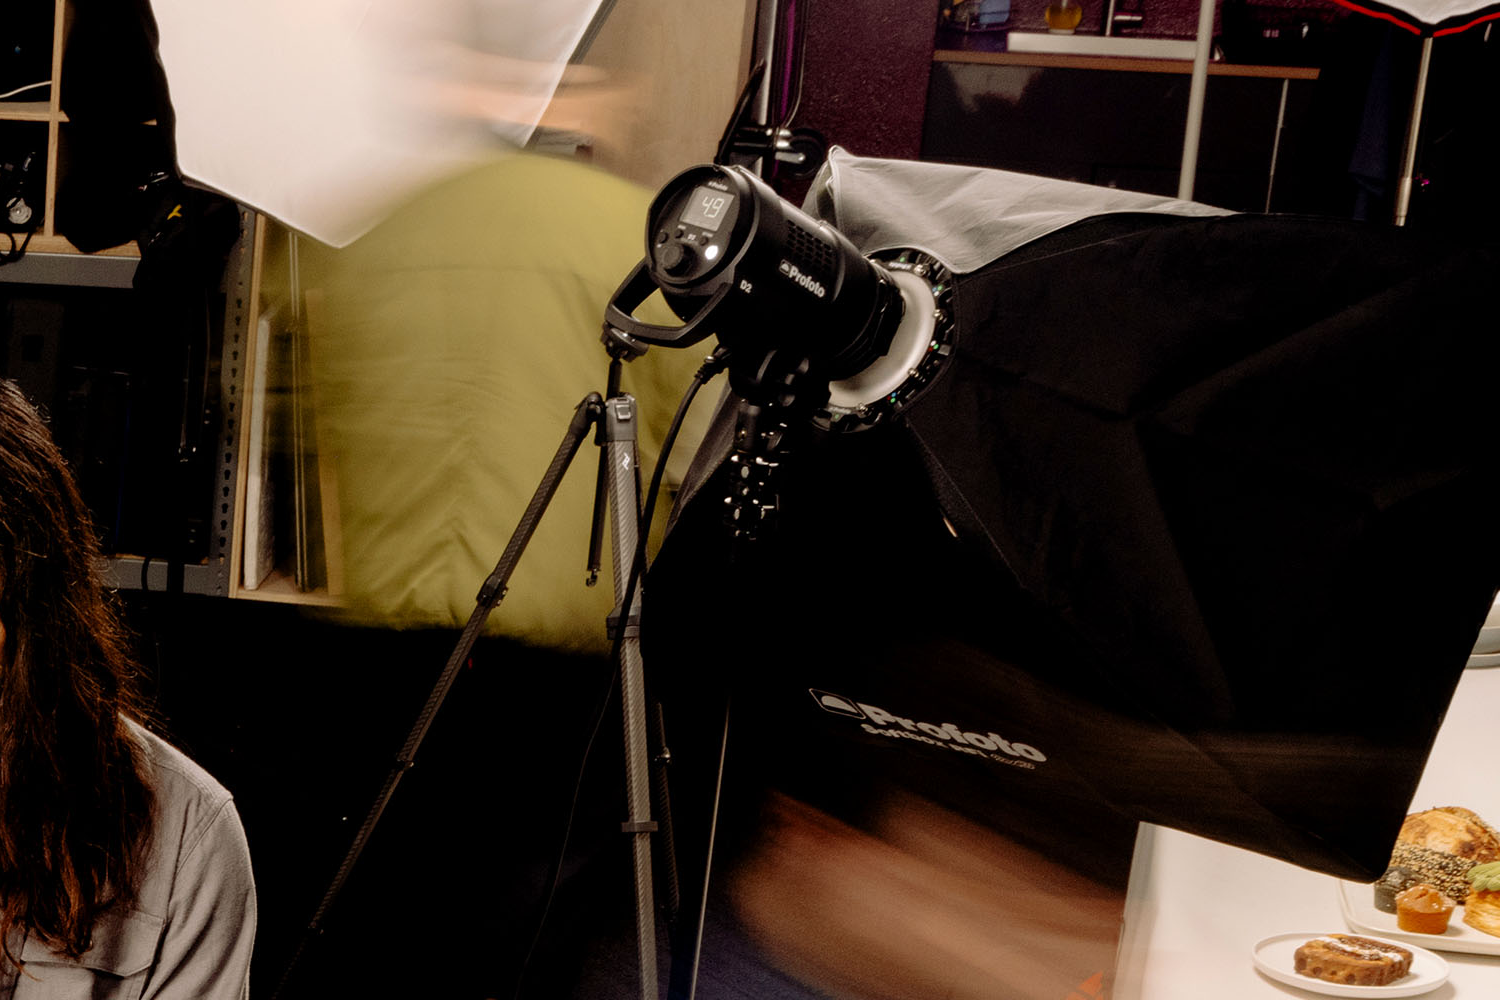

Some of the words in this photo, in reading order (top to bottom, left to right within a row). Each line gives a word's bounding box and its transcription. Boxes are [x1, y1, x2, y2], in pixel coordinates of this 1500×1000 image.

[702, 196, 725, 218] 49
[740, 279, 753, 294] D2
[788, 265, 826, 298] Profoto
[856, 702, 1047, 762] Profoto
